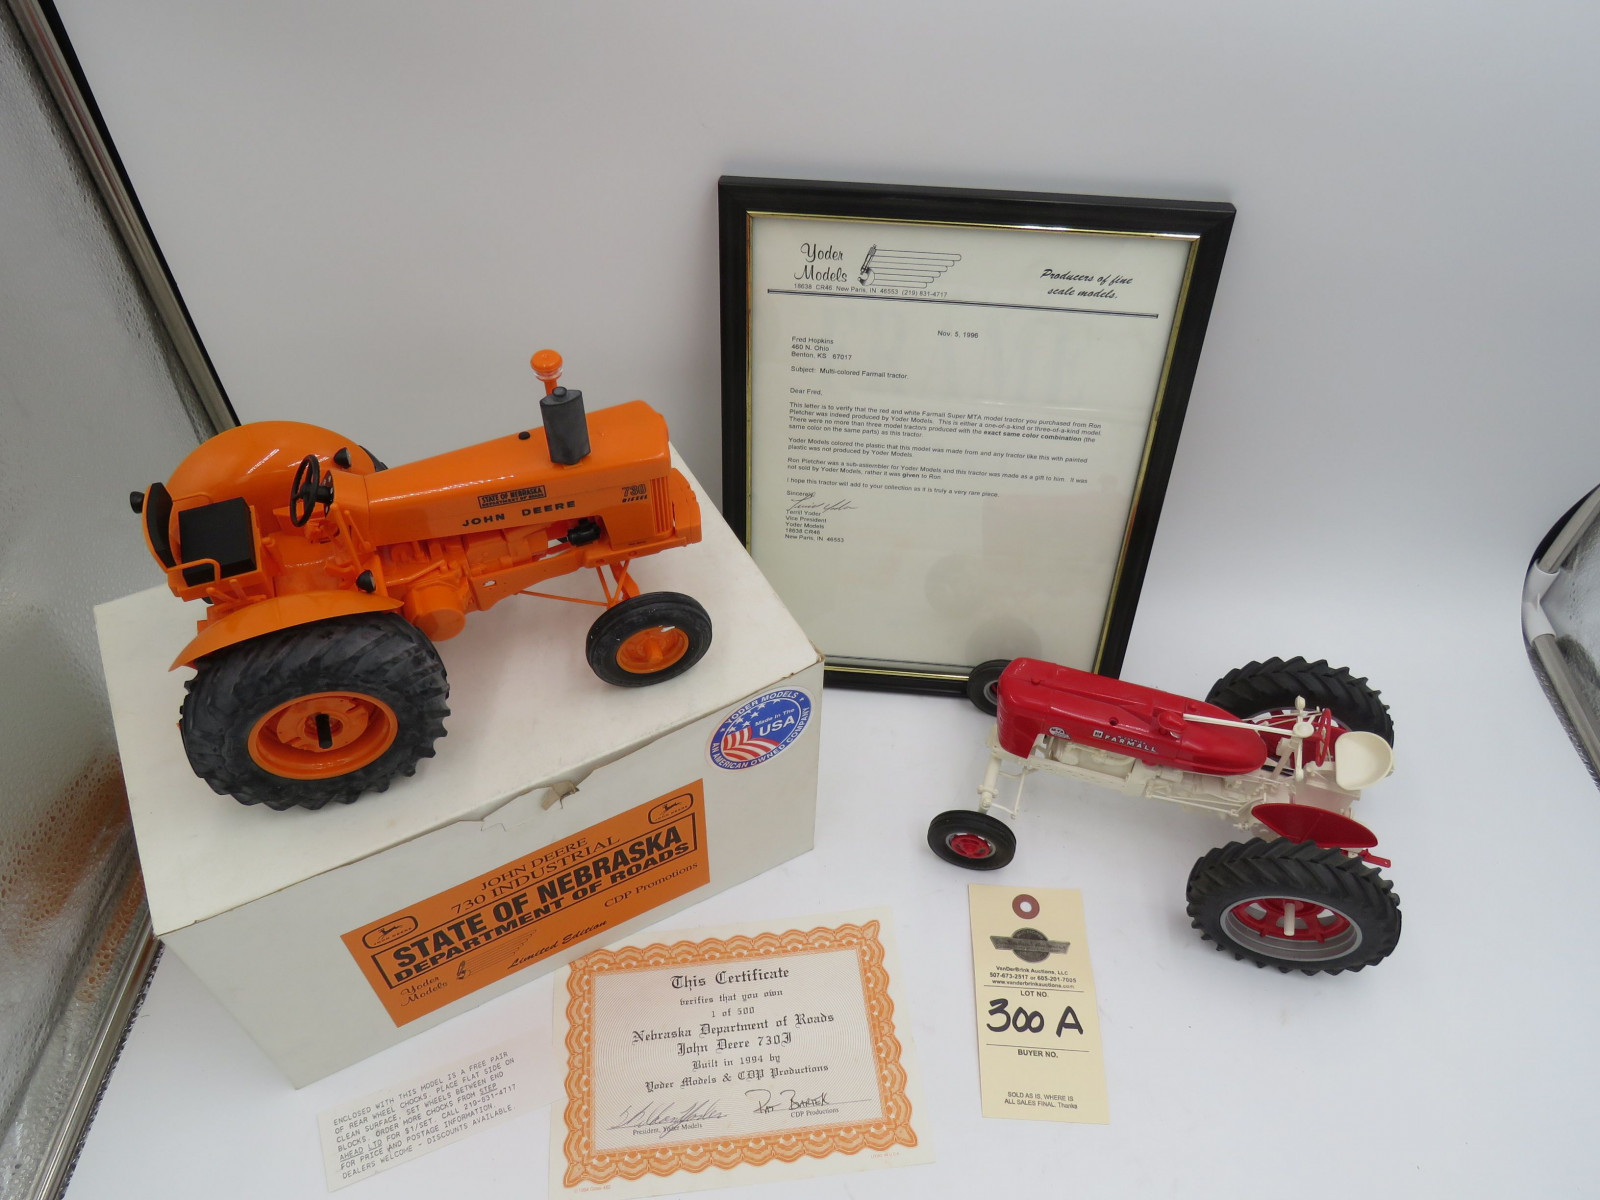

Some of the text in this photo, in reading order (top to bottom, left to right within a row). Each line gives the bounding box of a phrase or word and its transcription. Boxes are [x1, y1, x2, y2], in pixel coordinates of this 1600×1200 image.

[801, 243, 844, 263] Yoder
[794, 265, 847, 282] Models
[1040, 269, 1133, 286] Producers of fine
[1047, 287, 1118, 298] scale models.
[808, 337, 834, 345] Hopkins
[819, 368, 860, 376] Multi-colored
[1041, 434, 1081, 442] combination
[622, 484, 646, 496] 730
[462, 501, 576, 527] JOHN DEERE
[725, 691, 798, 724] YODER MODELS
[755, 716, 773, 726] Made
[760, 715, 795, 737] USA
[712, 707, 810, 769] AN AMERICAN OWNED COMPANY
[1105, 735, 1156, 752] FARMALL
[451, 836, 620, 914] 730 INDUSTRIAL
[481, 838, 587, 891] JOHN DEERE
[604, 863, 698, 908] CDP Promotions
[393, 826, 682, 967] STATE OF NEBRASKA
[394, 897, 565, 982] DEPARTMENT
[572, 882, 602, 901] OF
[610, 842, 689, 884] ROADS
[507, 920, 607, 969] Limited Edition
[401, 977, 439, 995] Yoder
[671, 968, 790, 990] This Certificate
[401, 981, 448, 1006] Models
[680, 989, 783, 1006] verifies that you own
[722, 1008, 732, 1017] of
[737, 1006, 755, 1016] 500
[986, 998, 1084, 1037] 300 A
[632, 1013, 834, 1045] Nebraska Department of Roads
[677, 1042, 708, 1056] John
[715, 1038, 750, 1054] Deere
[1018, 1049, 1043, 1057] BUYER
[692, 1060, 718, 1072] Built
[740, 1055, 763, 1065] 1994
[769, 1054, 781, 1064] by
[333, 1106, 371, 1126] ENCLOSED
[375, 1098, 395, 1109] WITH
[398, 1089, 417, 1100] THIS
[420, 1078, 443, 1091] MODEL
[448, 1072, 456, 1080] IS
[469, 1060, 486, 1071] FREE
[490, 1051, 508, 1063] PAIR
[645, 1065, 829, 1092] Yoder Models & CDP Productions
[335, 1126, 344, 1135] OF
[349, 1117, 369, 1129] REAR
[372, 1107, 395, 1120] WHEEL
[436, 1080, 458, 1094] PLACE
[462, 1072, 480, 1083] FLAT
[484, 1063, 502, 1075] SIDE
[505, 1058, 515, 1066] ON
[336, 1071, 504, 1143] CLEAN SET WHEELS BETWEEN END
[375, 1093, 476, 1137] ORDER MORE CHOCKS FROM
[442, 1108, 459, 1119] CALL
[791, 1108, 839, 1118] CDP Productions
[407, 1125, 439, 1142] POSTAGE
[427, 1123, 468, 1144] DISCOUNTS
